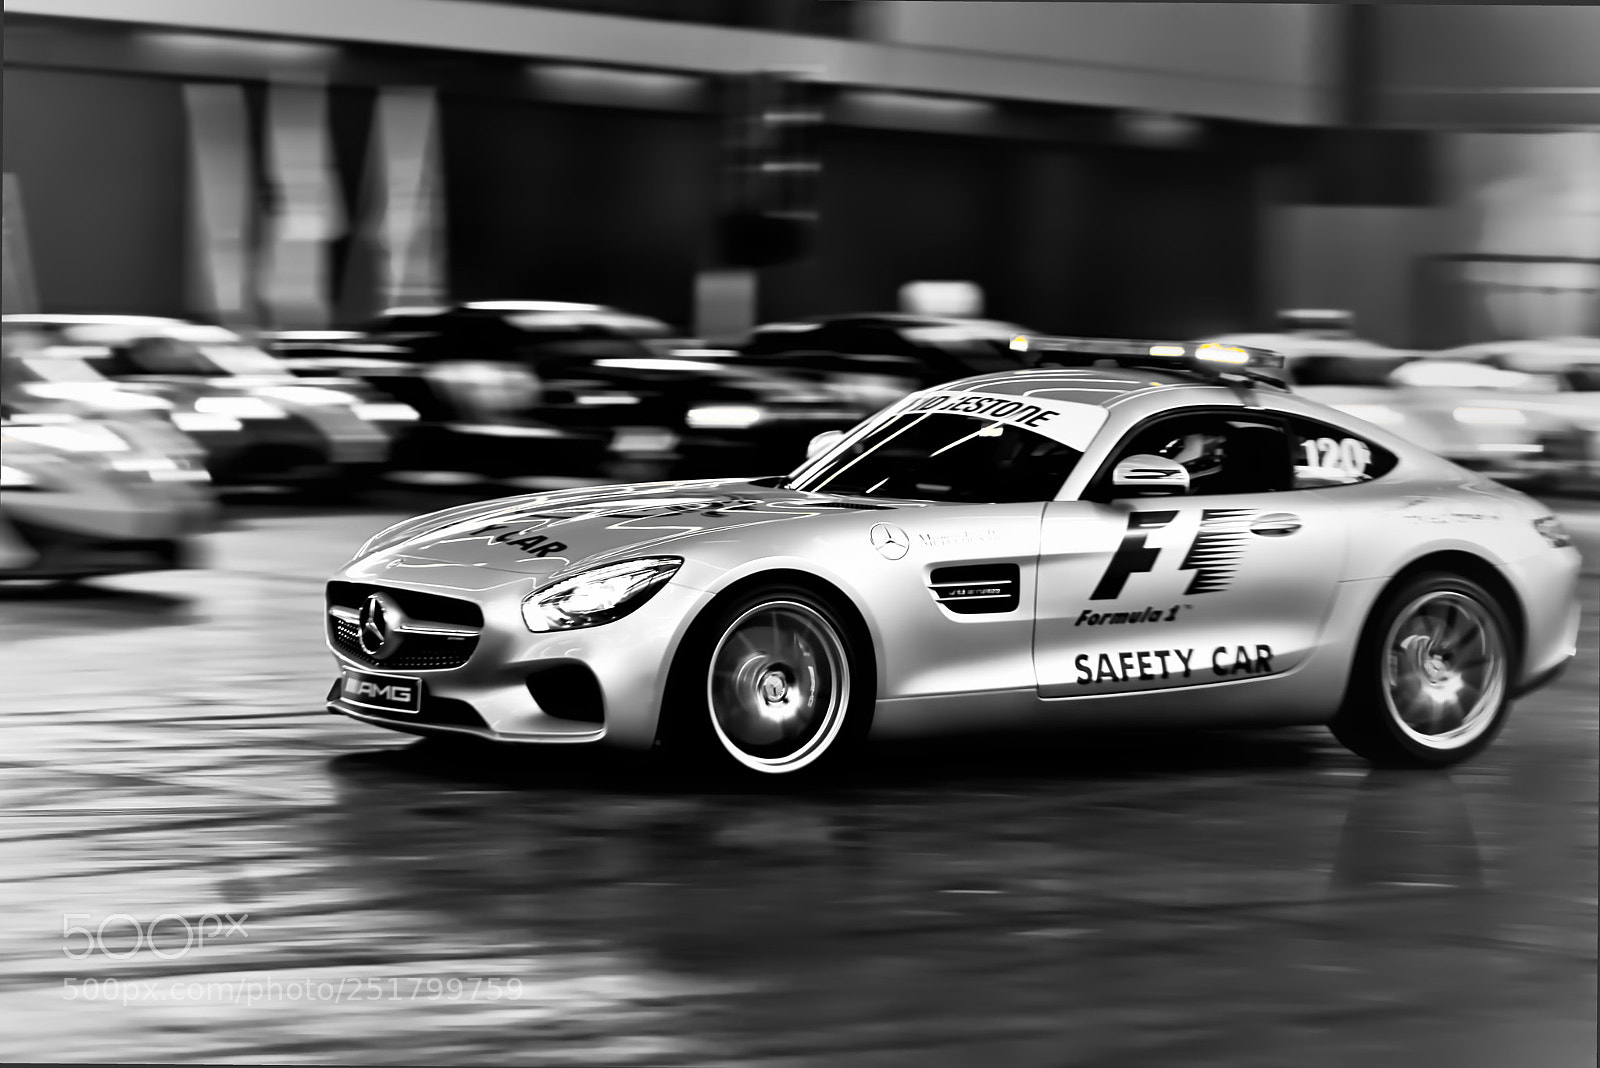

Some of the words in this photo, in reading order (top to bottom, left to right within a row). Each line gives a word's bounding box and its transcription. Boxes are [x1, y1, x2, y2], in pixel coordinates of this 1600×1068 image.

[1089, 507, 1258, 600] F1
[1074, 606, 1165, 627] Formula
[1074, 648, 1195, 685] SAFETY
[1211, 644, 1274, 676] CAR
[359, 681, 412, 703] AMG
